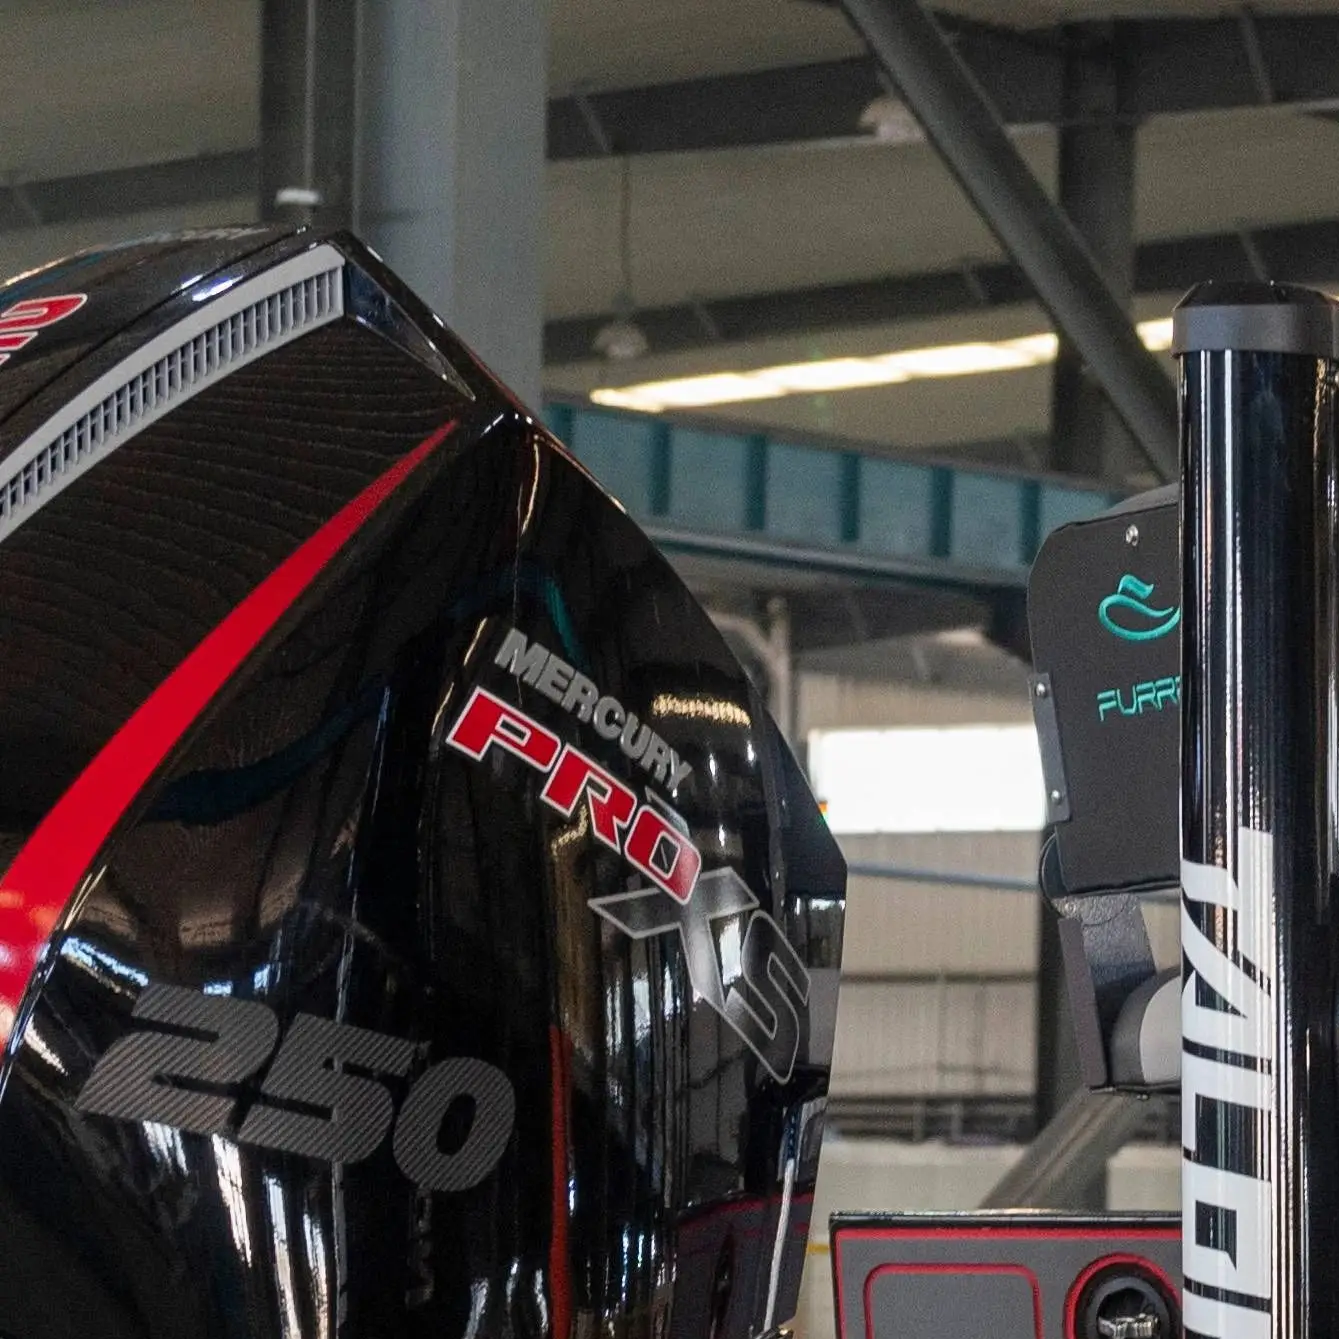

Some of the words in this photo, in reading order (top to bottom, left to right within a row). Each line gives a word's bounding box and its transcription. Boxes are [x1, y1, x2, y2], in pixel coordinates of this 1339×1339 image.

[495, 628, 692, 791] MERCURY
[1096, 675, 1181, 722] FURR
[446, 686, 702, 905] PRO
[587, 787, 812, 1085] XS
[73, 982, 518, 1193] 250
